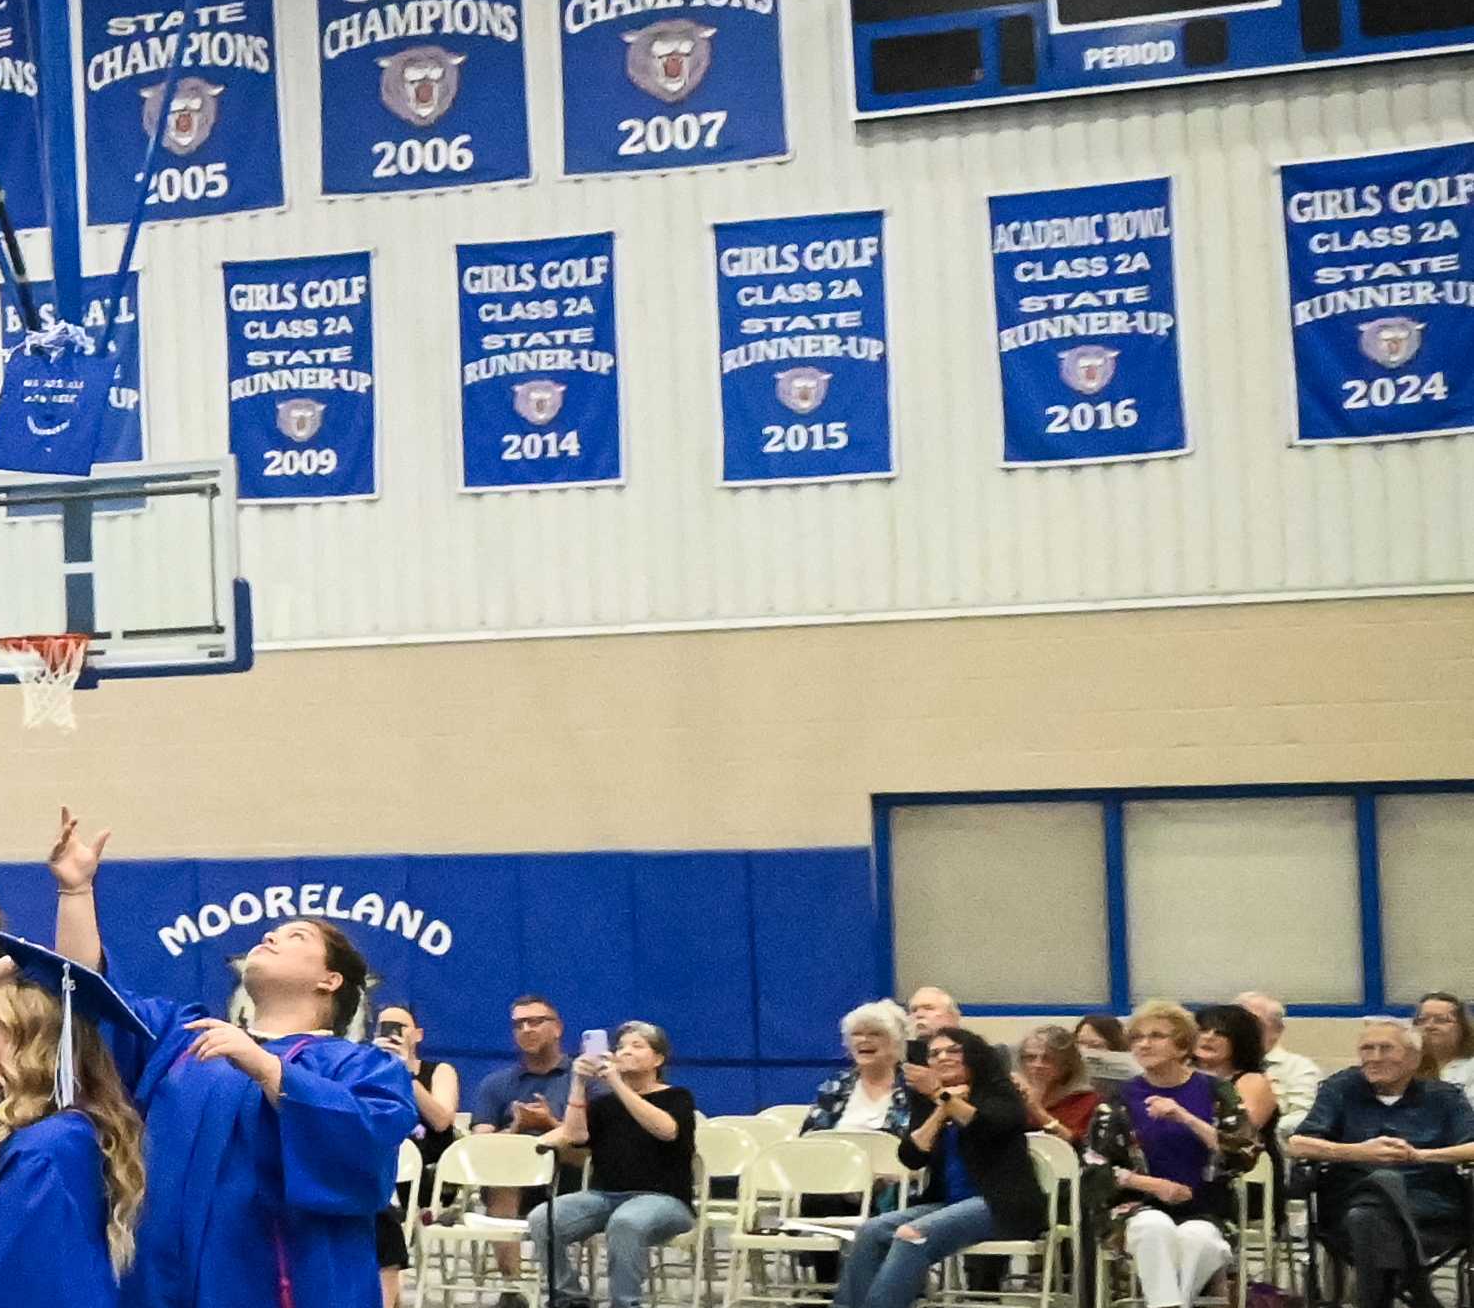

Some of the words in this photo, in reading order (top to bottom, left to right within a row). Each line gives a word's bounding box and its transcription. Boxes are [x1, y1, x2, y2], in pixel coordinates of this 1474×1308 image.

[1083, 39, 1175, 71] PERIOD
[617, 111, 728, 156] 2007
[371, 134, 474, 177] 2006
[1288, 185, 1382, 224] GIRLS
[1388, 173, 1474, 214] GOLF
[993, 215, 1104, 254] ACADEMIC
[1107, 206, 1171, 242] BOWL
[1308, 224, 1412, 254] CLASS
[1418, 219, 1459, 243] 2A
[463, 263, 535, 293] GIRLS
[540, 256, 609, 288] GOLF
[720, 244, 799, 278] GIRLS
[802, 237, 879, 272] GOLF
[1013, 256, 1108, 282] CLASS
[1113, 252, 1151, 274] 2A
[1314, 253, 1460, 284] STATE
[229, 283, 297, 312] GIRLS
[301, 276, 368, 308] GOLF
[478, 299, 558, 322] CLASS
[563, 296, 594, 317] 2A
[737, 282, 823, 307] CLASS
[827, 278, 863, 299] 2A
[1018, 286, 1152, 313] STATE
[243, 318, 319, 340] CLASS
[323, 316, 353, 335] 2A
[481, 328, 594, 349] STATE
[739, 311, 862, 334] STATE
[1000, 311, 1174, 352] RUNNER-UP
[246, 346, 353, 366] STATE
[464, 348, 615, 386] RUNNER-UP
[723, 335, 884, 374] RUNNER-UP
[231, 367, 373, 402] RUNNER-UP
[1342, 371, 1448, 410] 2024
[1045, 398, 1139, 434] 2016
[501, 431, 581, 460] 2014
[761, 422, 849, 452] 2015
[263, 449, 338, 477] 2009
[157, 883, 454, 958] MOORELAND
